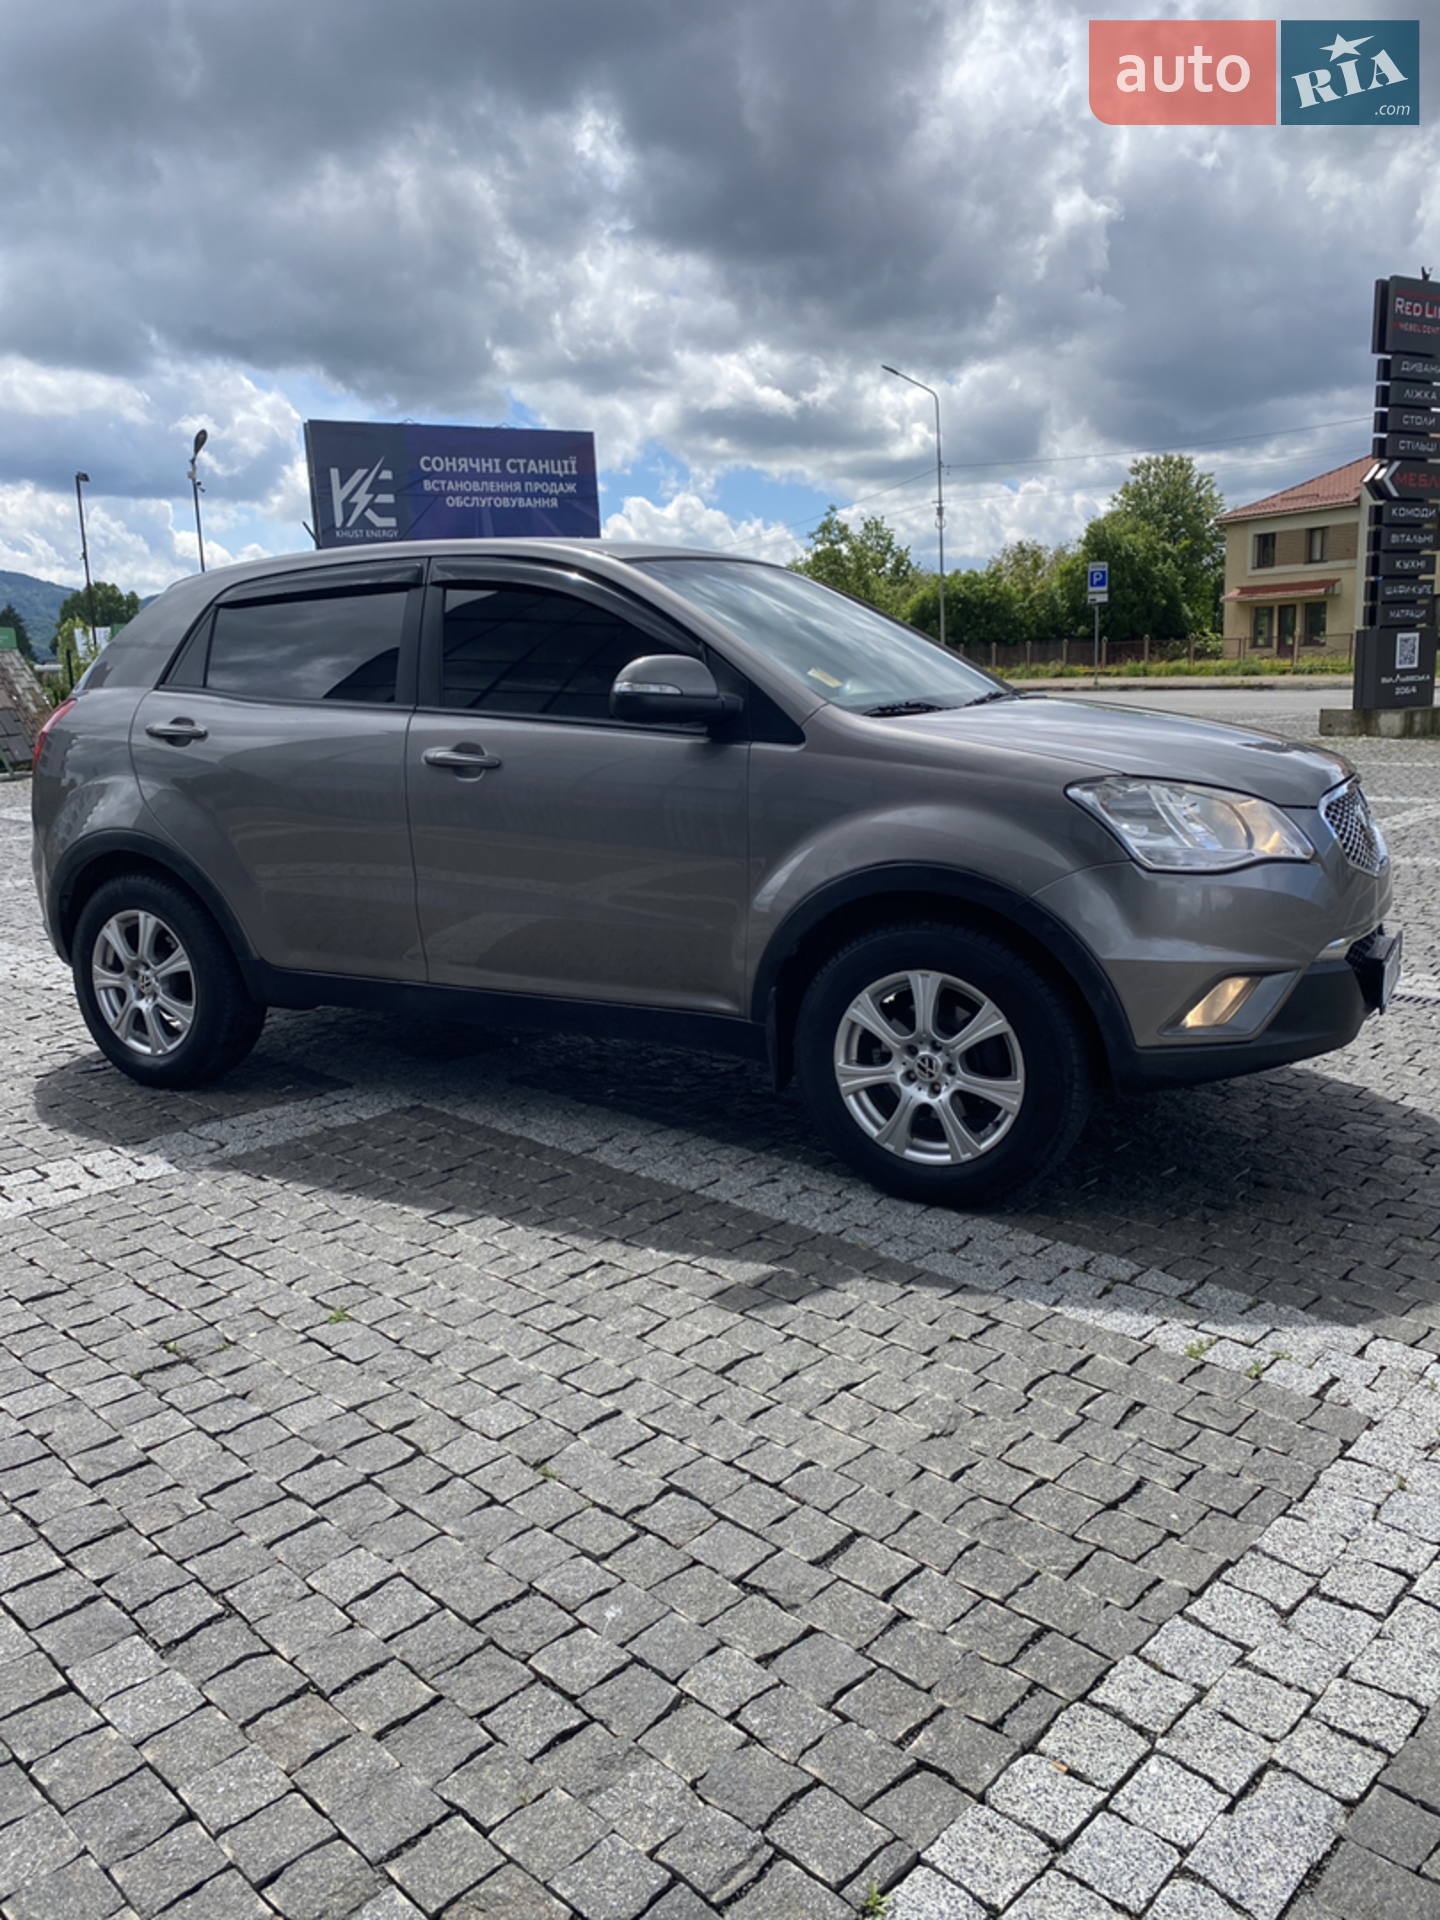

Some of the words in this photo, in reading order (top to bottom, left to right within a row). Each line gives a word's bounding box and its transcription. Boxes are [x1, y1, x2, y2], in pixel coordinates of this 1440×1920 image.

[1404, 389, 1437, 401] ЛІЖКА
[1402, 415, 1436, 426] СТОЛИ
[1399, 440, 1437, 452] СТІЛЬЦІ
[420, 456, 502, 474] СОНЯЧНІ
[506, 456, 578, 477] СТАНЦІЇ
[423, 480, 522, 493] ВСТАНОВЛЕННЯ
[525, 481, 577, 495] ПРОДАЖ
[446, 496, 558, 508] ОБСЛУГОВУВАННЯ
[1391, 508, 1436, 518] КОМОДИ
[335, 529, 363, 538] KHUST
[366, 529, 398, 538] ENERGY
[1390, 533, 1433, 544] ВІТАЛЬНІ
[1395, 559, 1426, 569] КУХНІ
